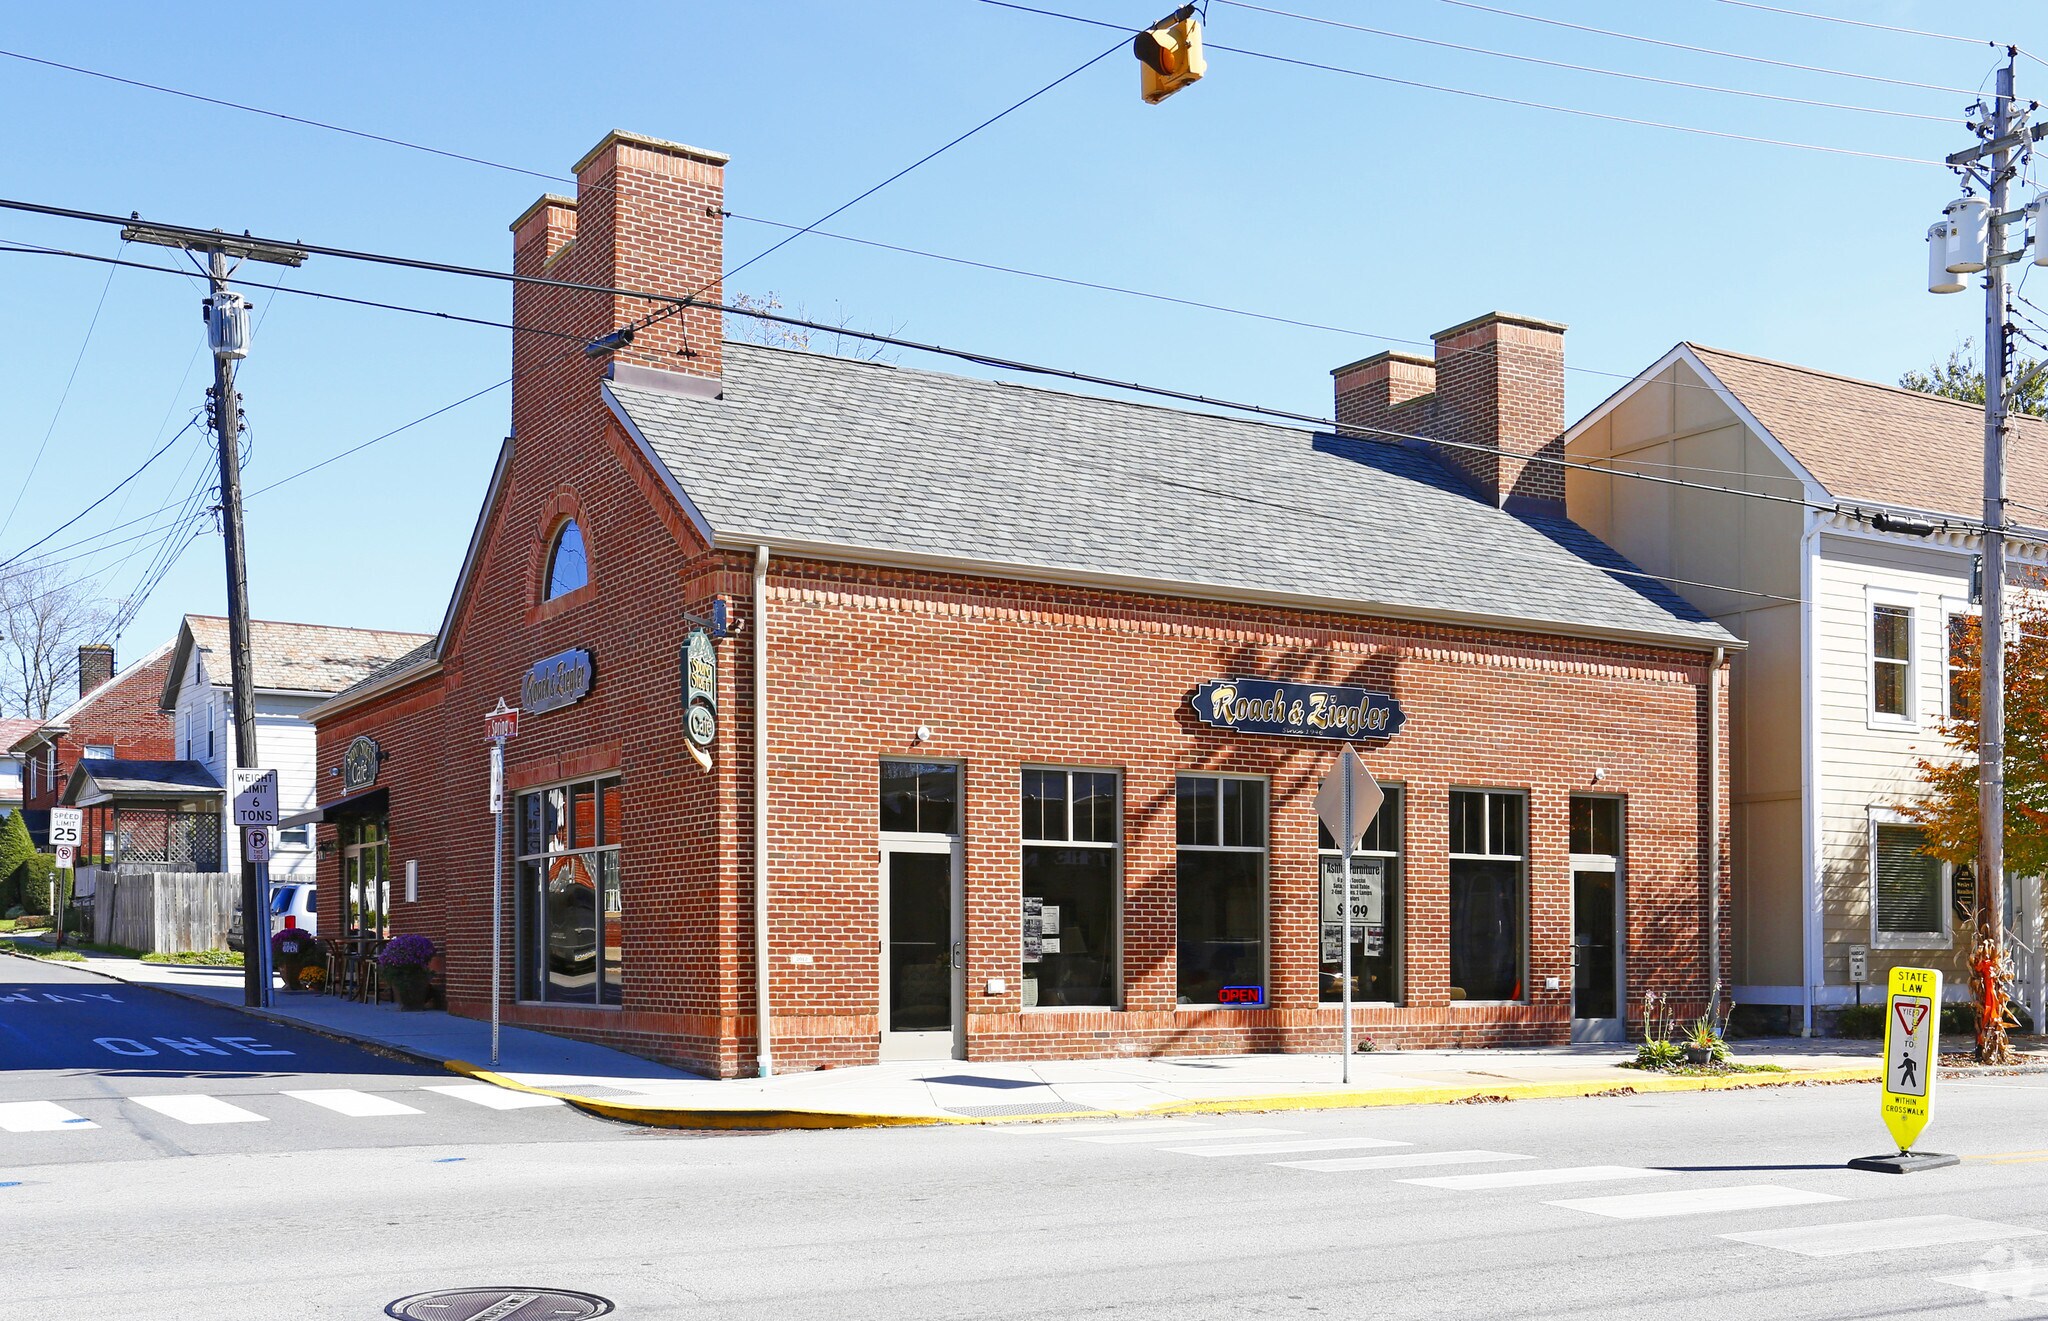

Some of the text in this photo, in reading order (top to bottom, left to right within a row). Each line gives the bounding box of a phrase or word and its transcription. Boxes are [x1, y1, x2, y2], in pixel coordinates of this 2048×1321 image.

[1211, 685, 1390, 736] Roach & Ziegler
[492, 719, 509, 737] Spring
[237, 774, 273, 783] WEIGHT
[243, 785, 268, 794] LIMIT
[252, 797, 260, 808] 6
[54, 812, 79, 820] SPEED
[240, 810, 273, 821] TONS
[54, 827, 77, 841] 25
[1898, 971, 1928, 982] STATE
[1902, 984, 1922, 993] LAW
[1219, 989, 1258, 1002] OPEN
[92, 1036, 297, 1057] ONE
[1904, 1040, 1914, 1048] TO
[1894, 1096, 1917, 1106] WITHIN
[1886, 1104, 1925, 1116] CROSSWALK
